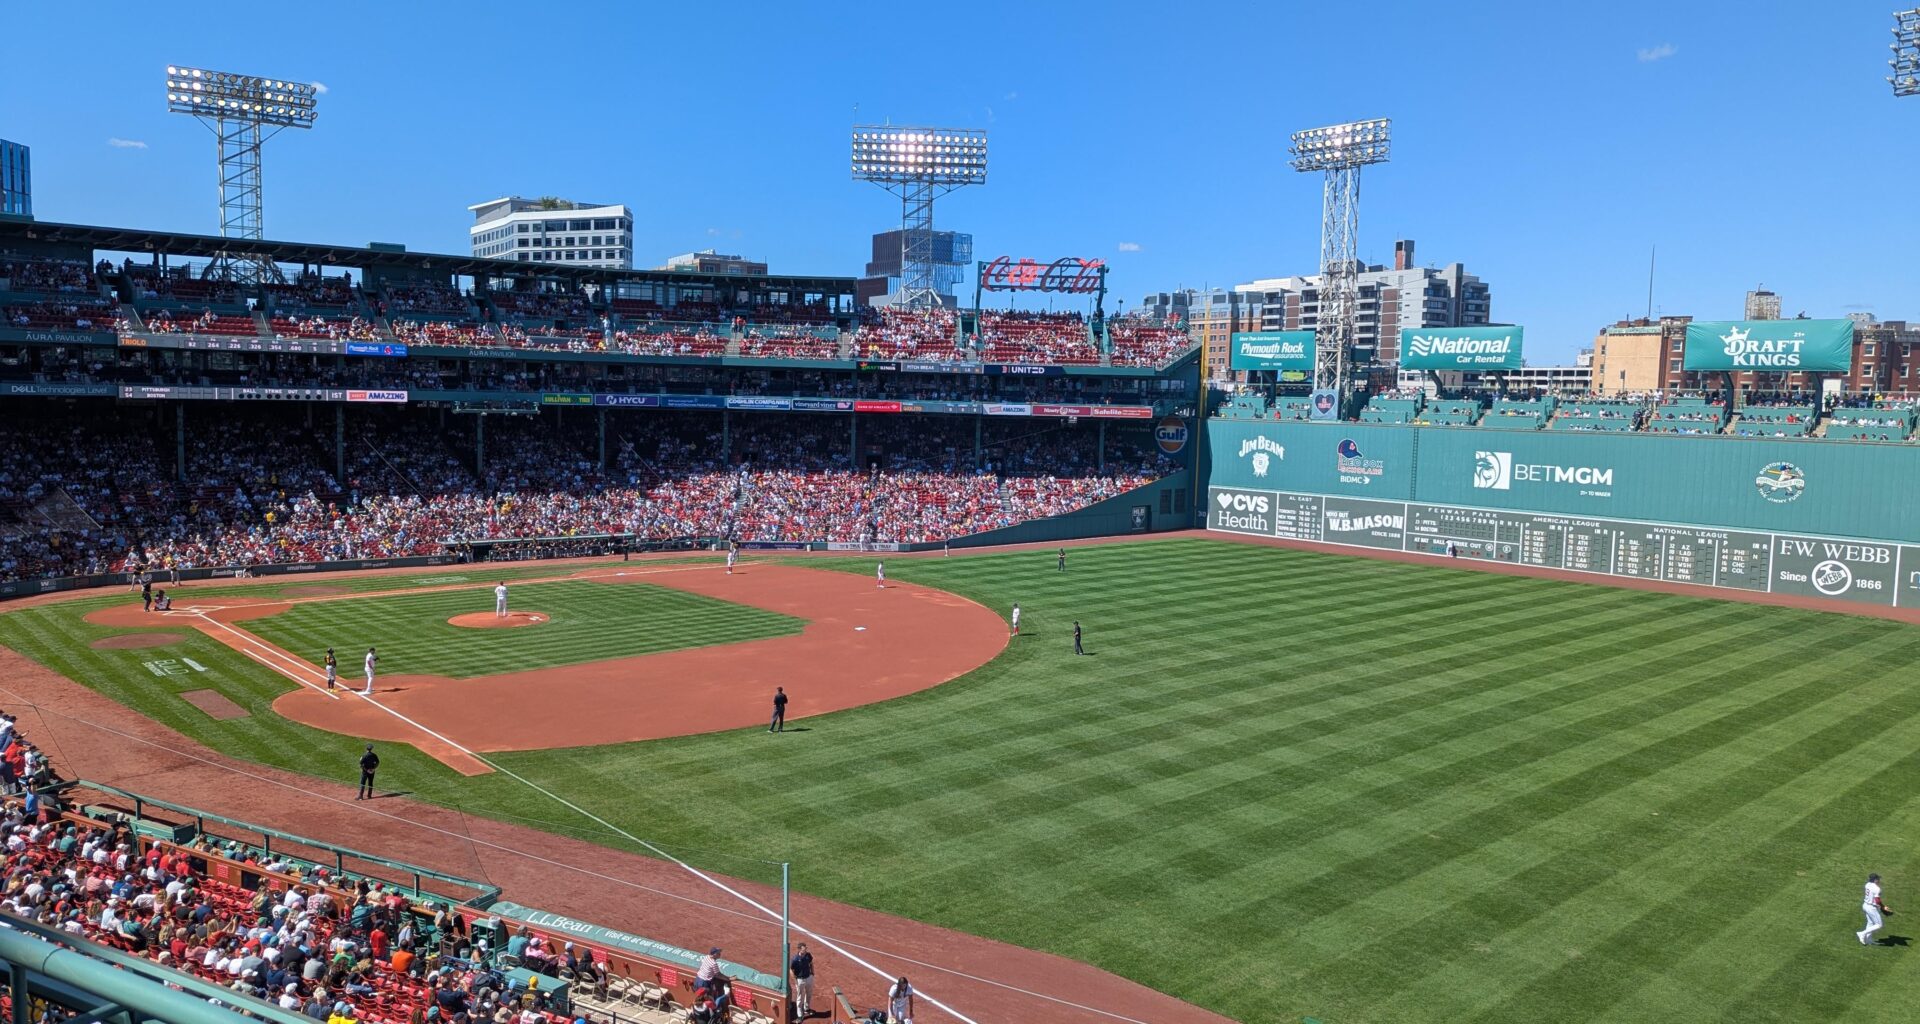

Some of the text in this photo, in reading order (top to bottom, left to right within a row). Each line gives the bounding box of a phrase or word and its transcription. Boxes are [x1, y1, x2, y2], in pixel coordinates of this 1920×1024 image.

[55, 334, 92, 342] PAVILION
[1240, 342, 1304, 354] Plymouth Rock
[1724, 338, 1804, 356] DRAFT
[1474, 355, 1506, 363] Rental
[1733, 353, 1800, 366] KINGS
[37, 385, 86, 394] Technologies
[1156, 427, 1186, 440] Gulf
[1238, 435, 1286, 460] JIM BEAM
[1362, 460, 1384, 468] SOX
[1759, 462, 1780, 474] BOSTON
[1340, 476, 1363, 484] BIDMC
[1514, 464, 1613, 486] BETMGM
[1233, 494, 1269, 513] CVS
[1218, 510, 1269, 531] Health
[1654, 528, 1692, 536] NATIONAL
[1780, 540, 1890, 564] F.W. WEBB
[1780, 570, 1882, 590] Since 1866
[526, 911, 592, 933] L.L.Bean
[604, 929, 620, 940] Visit
[640, 938, 652, 948] our
[653, 941, 670, 953] store
[672, 947, 680, 955] in
[680, 948, 698, 961] One
